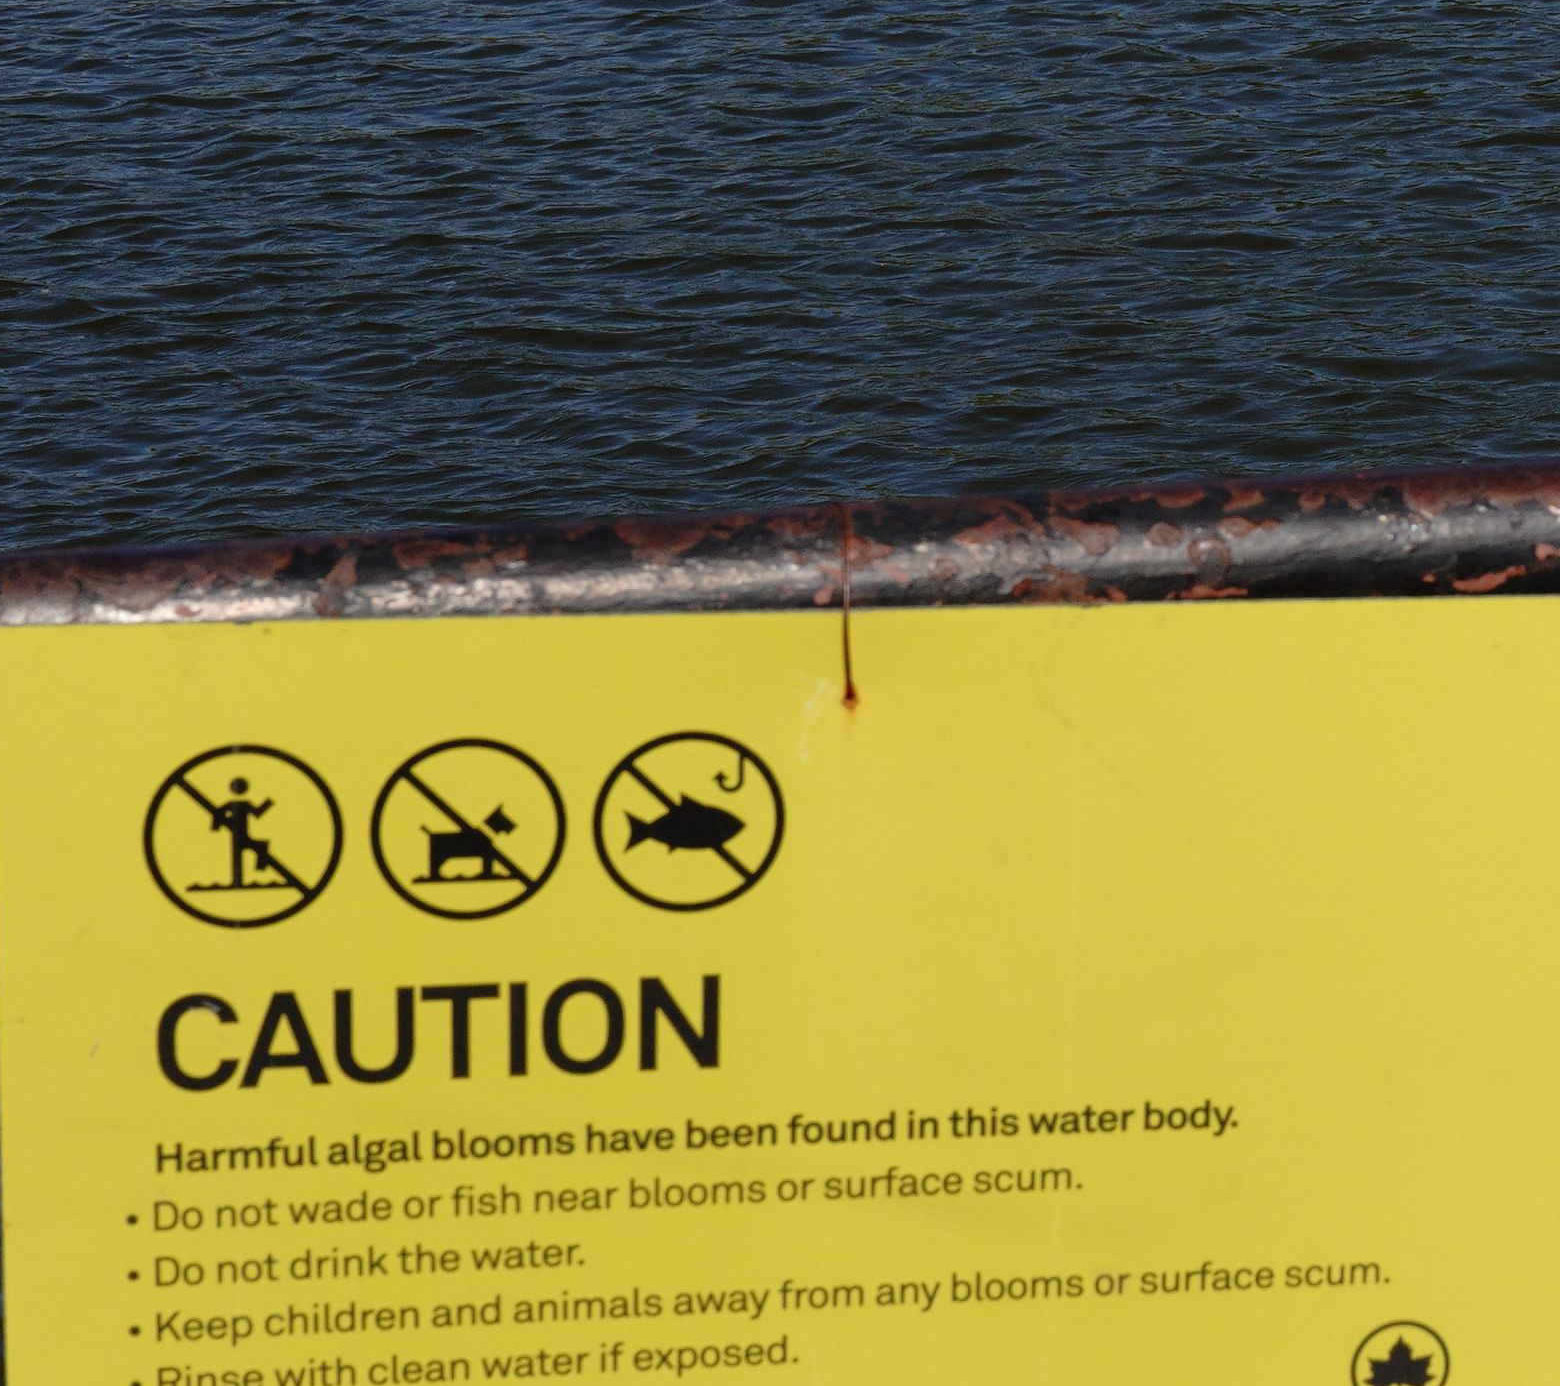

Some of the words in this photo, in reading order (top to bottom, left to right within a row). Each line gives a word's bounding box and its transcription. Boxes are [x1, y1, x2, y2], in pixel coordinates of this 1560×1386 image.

[155, 972, 722, 1094] CAUTION
[155, 1135, 319, 1174] Harmful
[327, 1130, 423, 1174] algal
[431, 1128, 577, 1161] blooms
[585, 1122, 676, 1154] have
[685, 1118, 779, 1150] been
[786, 1110, 897, 1145] found
[907, 1109, 940, 1141] in
[947, 1106, 1020, 1139] this
[1028, 1104, 1136, 1136] water
[1143, 1098, 1239, 1138] body.
[152, 1200, 204, 1232] Do
[215, 1198, 279, 1229] not
[288, 1190, 393, 1225] wade
[402, 1195, 442, 1220] or
[451, 1184, 522, 1217] fish
[534, 1187, 619, 1213] near
[629, 1177, 767, 1209] blooms
[776, 1178, 816, 1203] or
[823, 1166, 963, 1201] surface
[973, 1167, 1083, 1194] scum.
[154, 1256, 205, 1288] Do
[216, 1254, 279, 1284] not
[289, 1245, 388, 1281] drink
[397, 1243, 461, 1275] the
[471, 1240, 585, 1271] water.
[155, 1311, 254, 1347] Keep
[264, 1301, 420, 1337] children
[431, 1294, 502, 1328] and
[513, 1287, 663, 1324] animals
[672, 1289, 770, 1320] away
[778, 1279, 865, 1310] from
[875, 1281, 941, 1313] any
[951, 1271, 1085, 1303] blooms
[1093, 1273, 1131, 1297] or
[1139, 1261, 1275, 1295] surface
[1284, 1262, 1390, 1289] scum.
[367, 1354, 471, 1386] clean
[481, 1349, 590, 1379] water
[599, 1341, 624, 1374] if
[632, 1334, 799, 1378] exposed.
